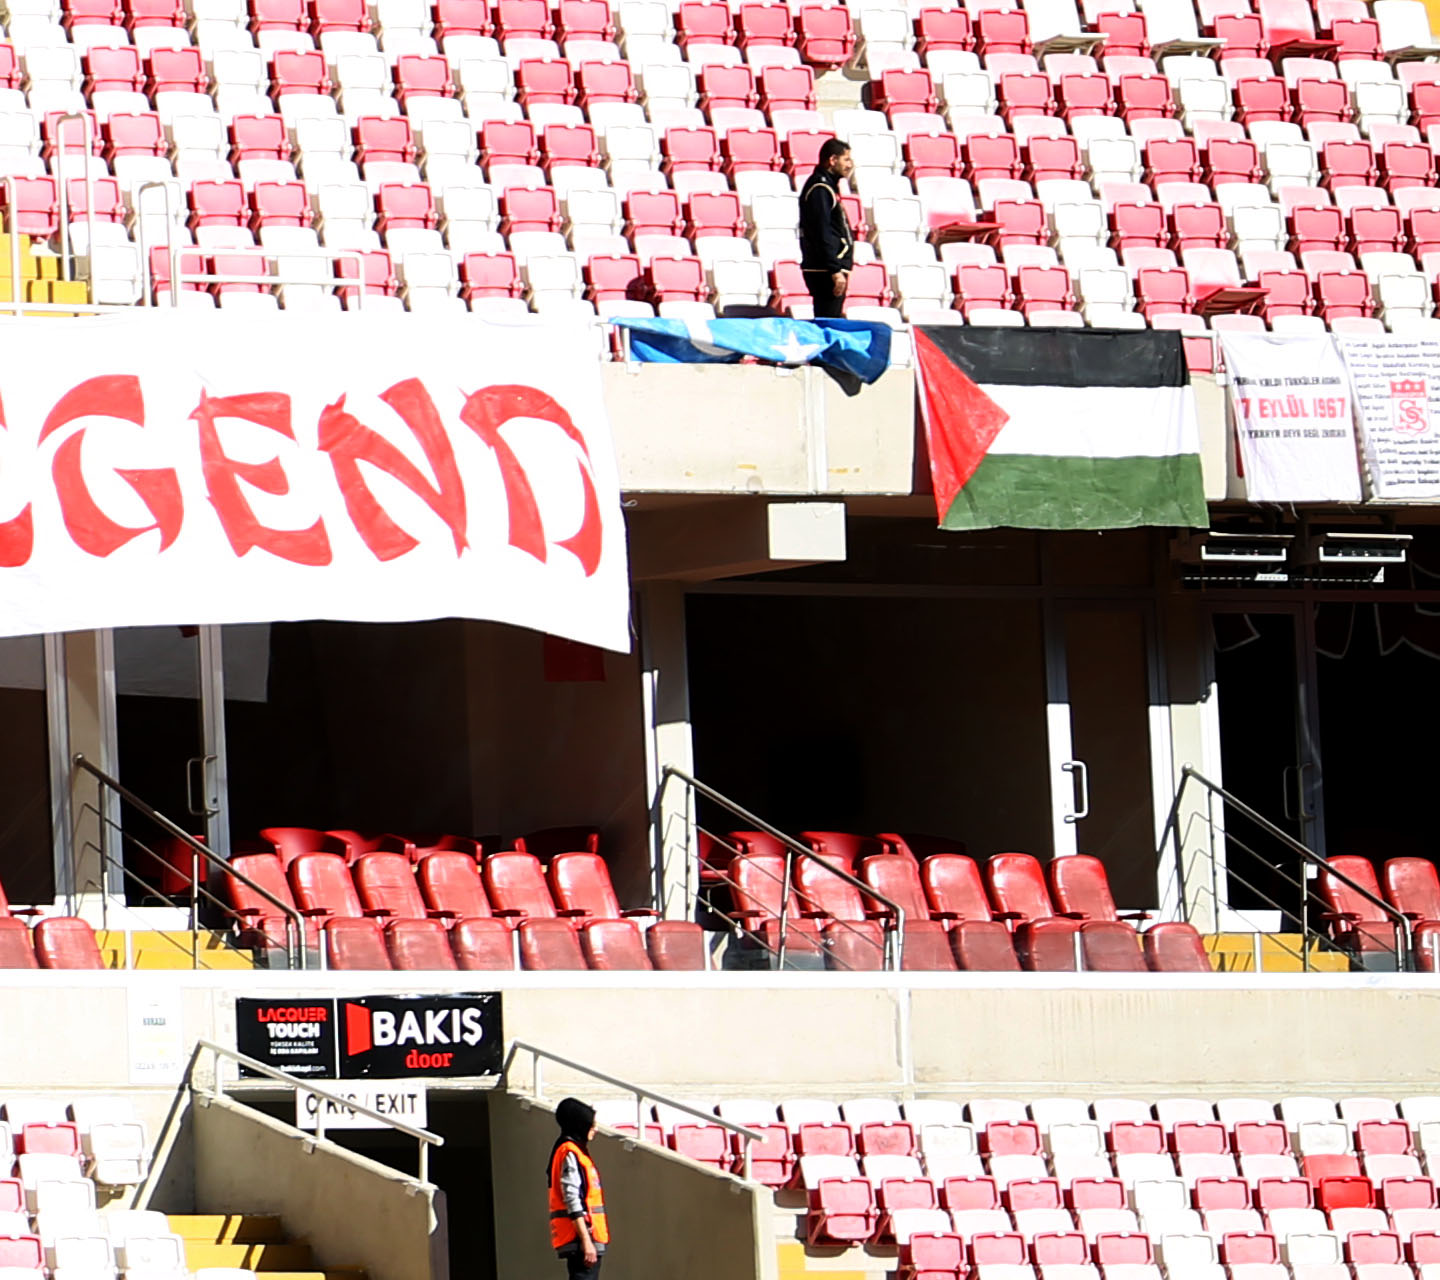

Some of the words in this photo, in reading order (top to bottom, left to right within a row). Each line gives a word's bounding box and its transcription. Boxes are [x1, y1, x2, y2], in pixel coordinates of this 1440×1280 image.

[1258, 394, 1310, 419] EYLÜL
[1313, 398, 1346, 419] 1967
[257, 1007, 327, 1022] LACQUER
[267, 1023, 320, 1038] TOUCH
[371, 1006, 483, 1049] BAKIŞ
[405, 1049, 454, 1070] door
[304, 1093, 358, 1119] ÇKIŞ
[376, 1093, 418, 1115] EXIT
